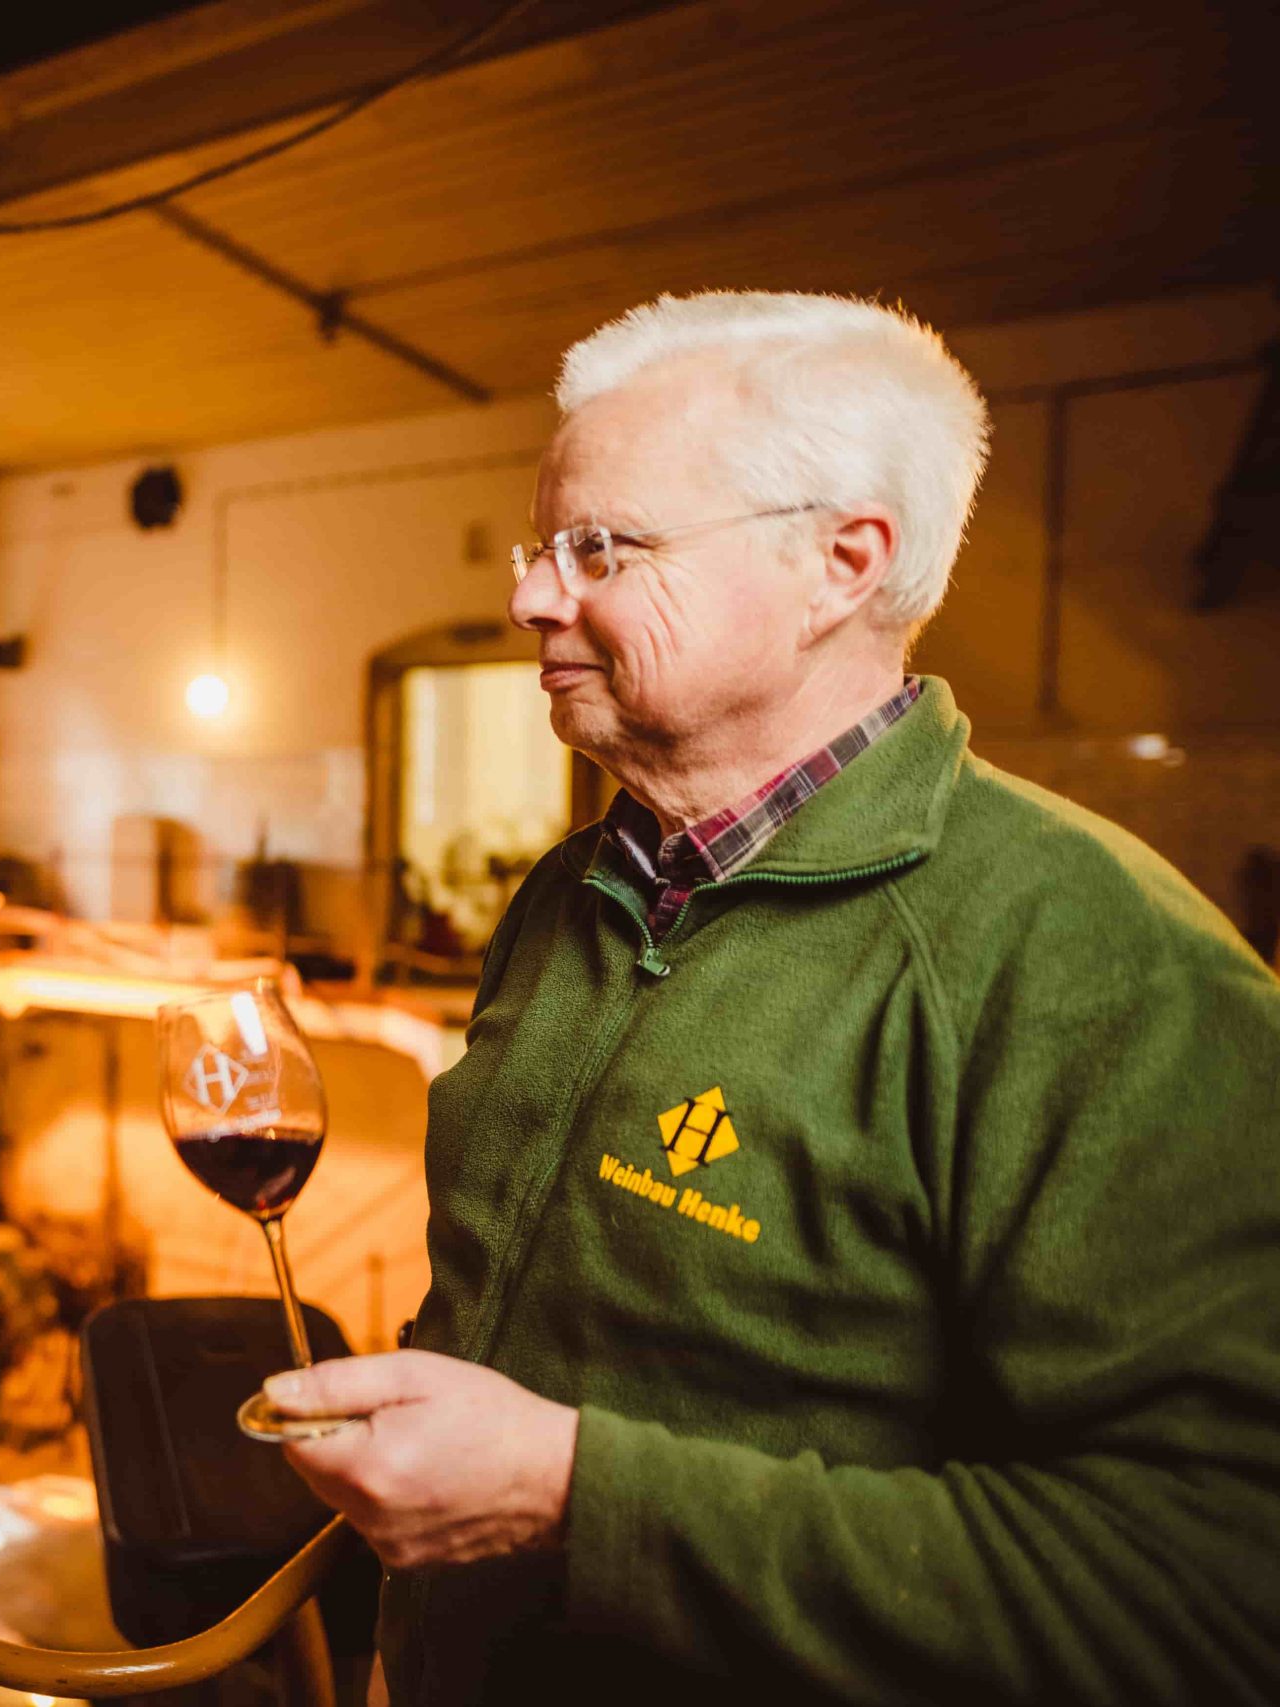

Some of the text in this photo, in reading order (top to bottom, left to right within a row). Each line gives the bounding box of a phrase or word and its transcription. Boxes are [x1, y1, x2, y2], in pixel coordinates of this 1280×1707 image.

[658, 1096, 733, 1168] H
[599, 1153, 761, 1244] Weinbau Henke
